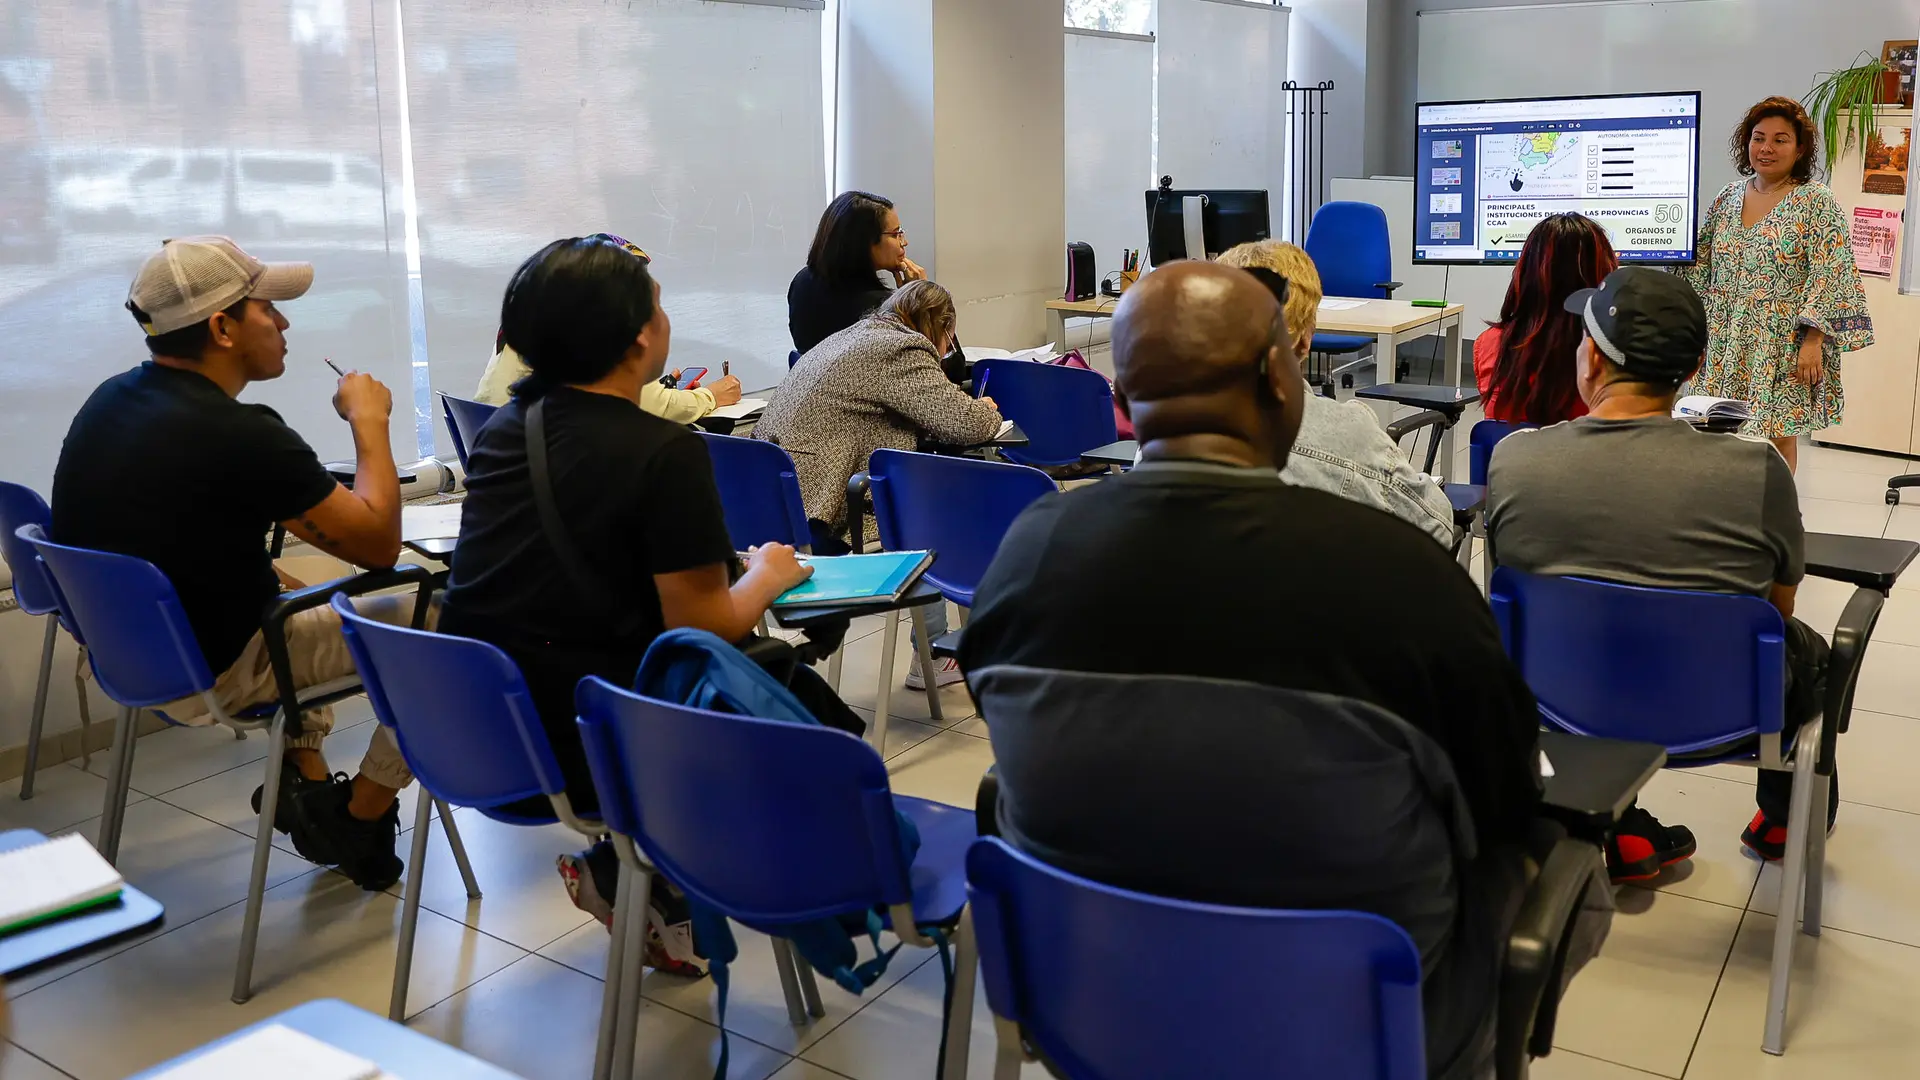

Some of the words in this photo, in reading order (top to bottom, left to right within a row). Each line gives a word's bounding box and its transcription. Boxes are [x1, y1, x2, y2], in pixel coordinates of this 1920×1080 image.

[1654, 203, 1684, 224] 50
[1853, 223, 1882, 232] Siguiendo
[1852, 229, 1873, 237] huellas
[1851, 235, 1874, 243] Mujeres
